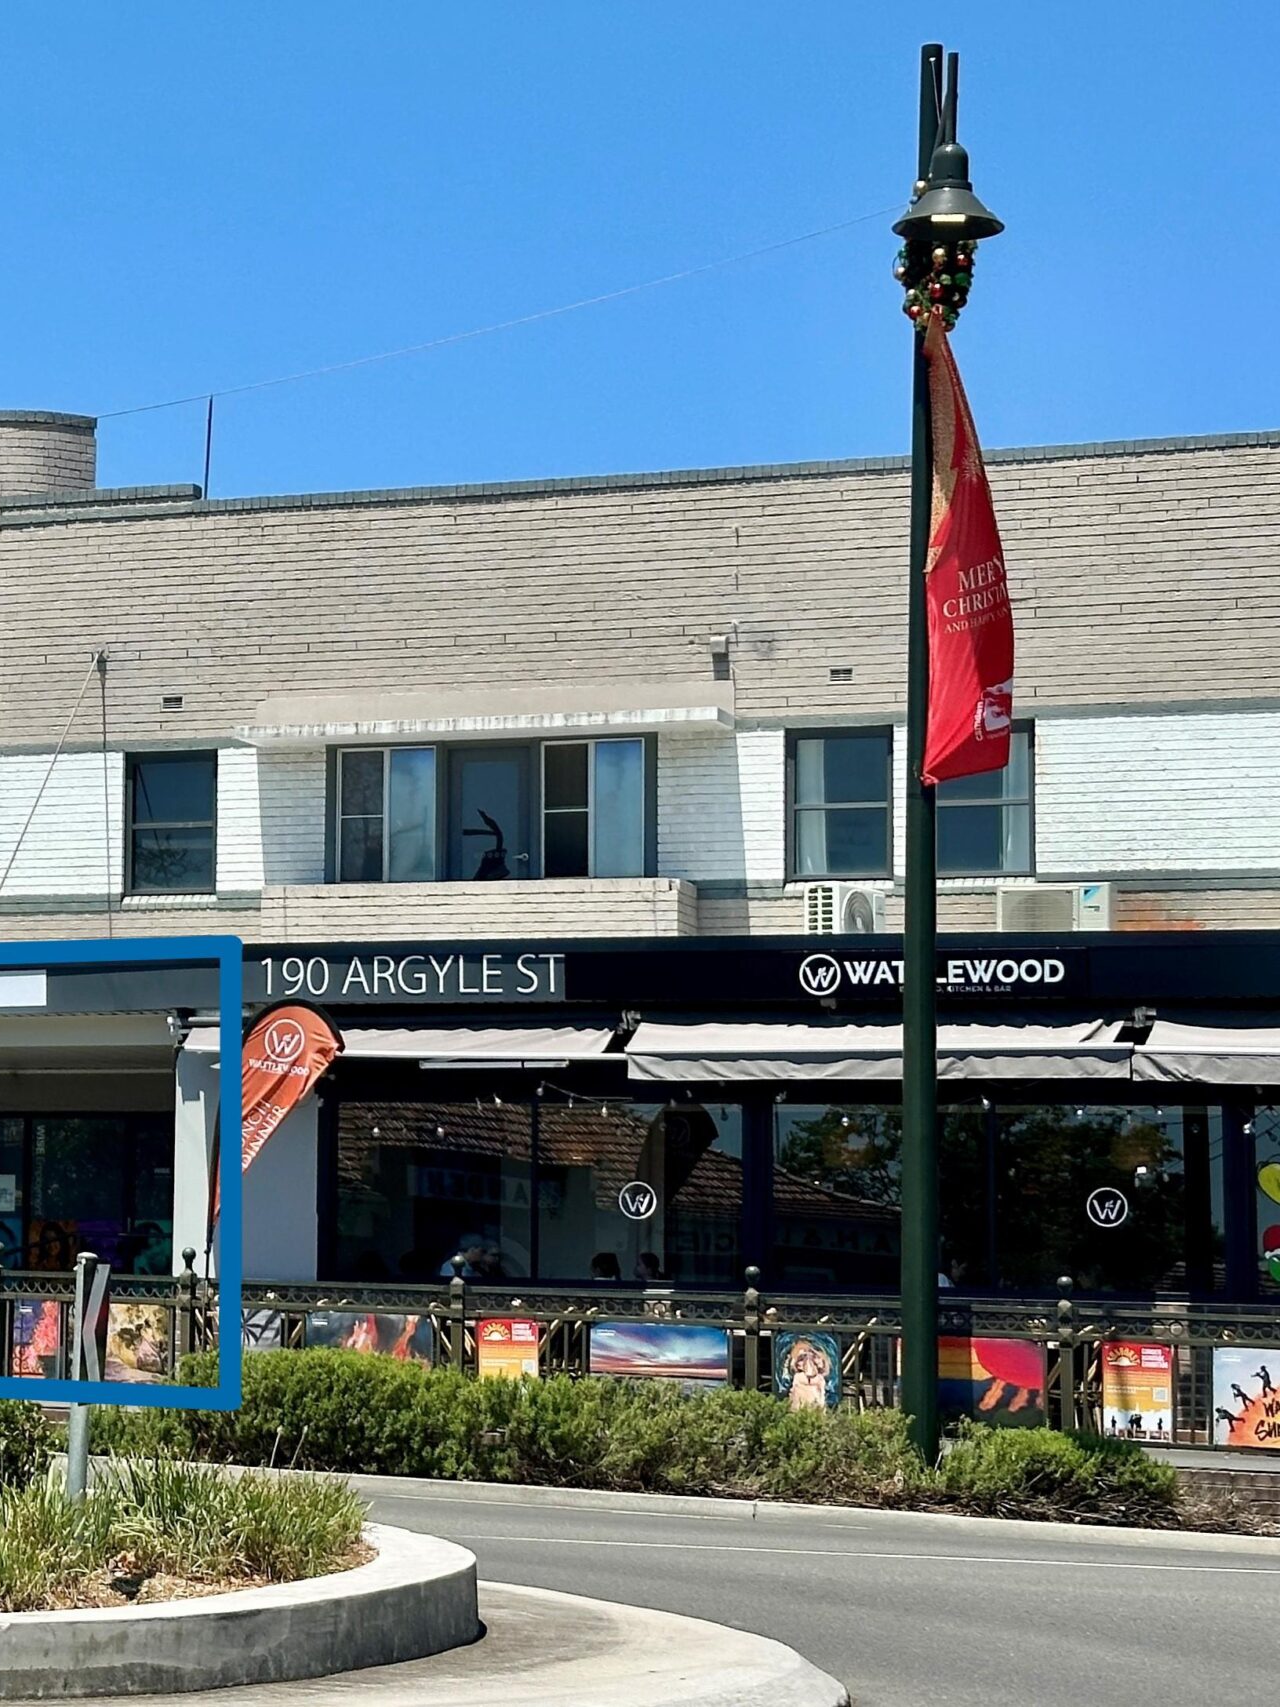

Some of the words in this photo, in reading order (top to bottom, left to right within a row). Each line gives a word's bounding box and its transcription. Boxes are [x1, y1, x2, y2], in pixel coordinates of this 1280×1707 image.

[944, 620, 969, 634] AND
[260, 956, 329, 996] 190
[341, 955, 503, 995] ARGYLE
[516, 953, 566, 994] ST
[843, 959, 1065, 985] WATEWOOD
[35, 1124, 46, 1155] WISE
[242, 1105, 289, 1169] DINNER
